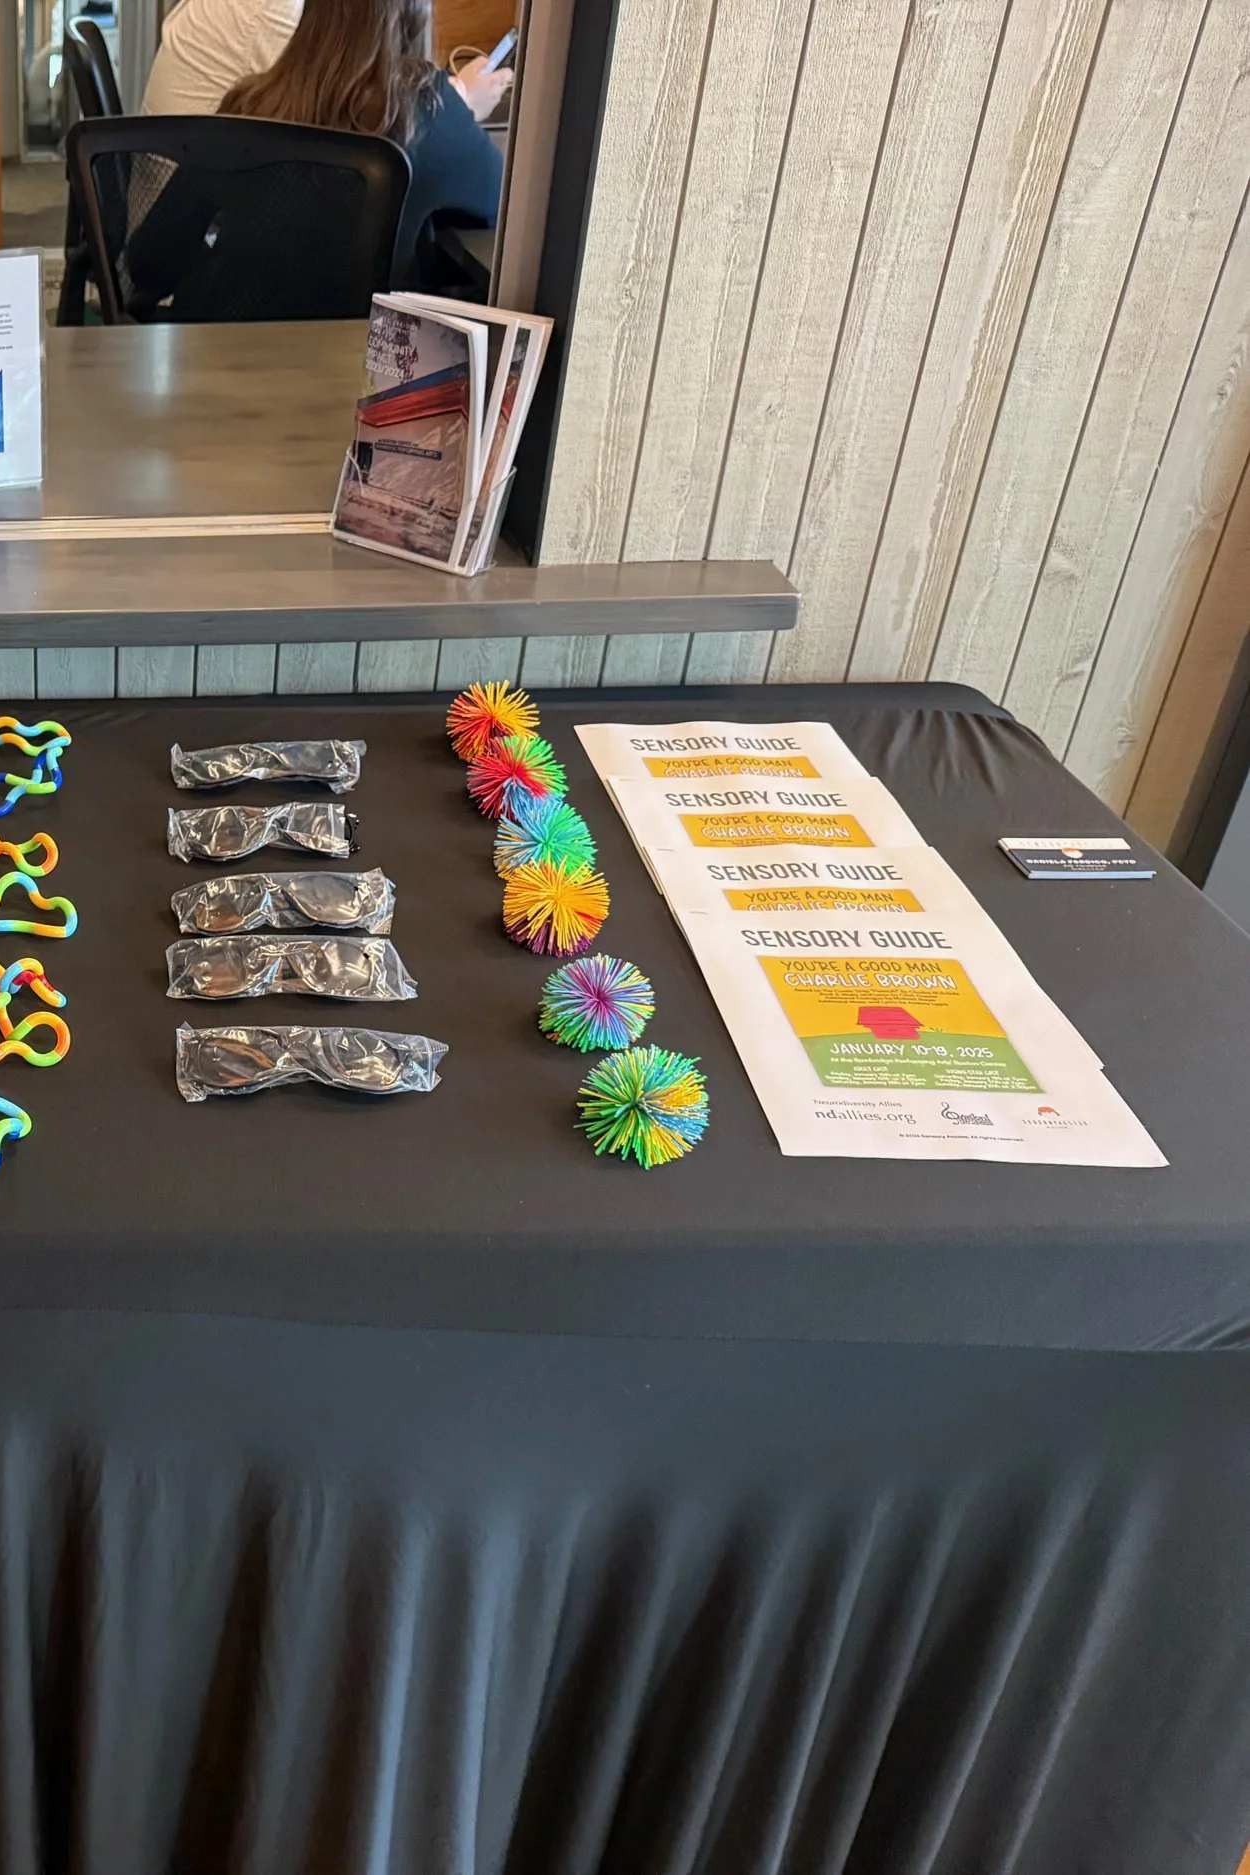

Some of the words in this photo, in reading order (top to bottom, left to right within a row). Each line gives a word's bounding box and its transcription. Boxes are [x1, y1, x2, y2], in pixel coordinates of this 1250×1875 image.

[630, 736, 728, 752] SENSORY
[734, 737, 801, 751] GUIDE
[662, 759, 710, 769] YOU'RE
[715, 758, 724, 767] A
[725, 757, 761, 766] GOOD
[763, 759, 793, 767] MAN
[665, 790, 769, 807] SENSORY
[776, 791, 848, 807] GUIDE
[699, 816, 750, 826] YOU'RE
[755, 816, 763, 824] A
[766, 815, 804, 825] GOOD
[808, 817, 838, 826] MAN
[702, 824, 778, 838] CHARLIE
[784, 825, 850, 838] BROWN
[707, 862, 820, 881] SENSORY
[826, 864, 903, 881] GUIDE
[743, 891, 799, 903] YOU'RE
[804, 891, 815, 900] A
[818, 890, 858, 901] GOOD
[860, 892, 894, 902] MAN
[741, 929, 862, 948] SENSORY
[869, 930, 953, 950] GUIDE
[780, 960, 840, 972] YOU'RE
[845, 961, 856, 972] A
[858, 961, 902, 973] GOOD
[905, 962, 943, 973] MAN
[783, 972, 872, 988] CHARLIE
[875, 973, 958, 990] BROWN
[830, 1043, 905, 1056] JANUARY
[956, 1046, 994, 1058] 2025
[813, 1099, 876, 1108] Neurodiversity
[878, 1099, 903, 1107] Allies
[815, 1109, 917, 1125] ndallies.org
